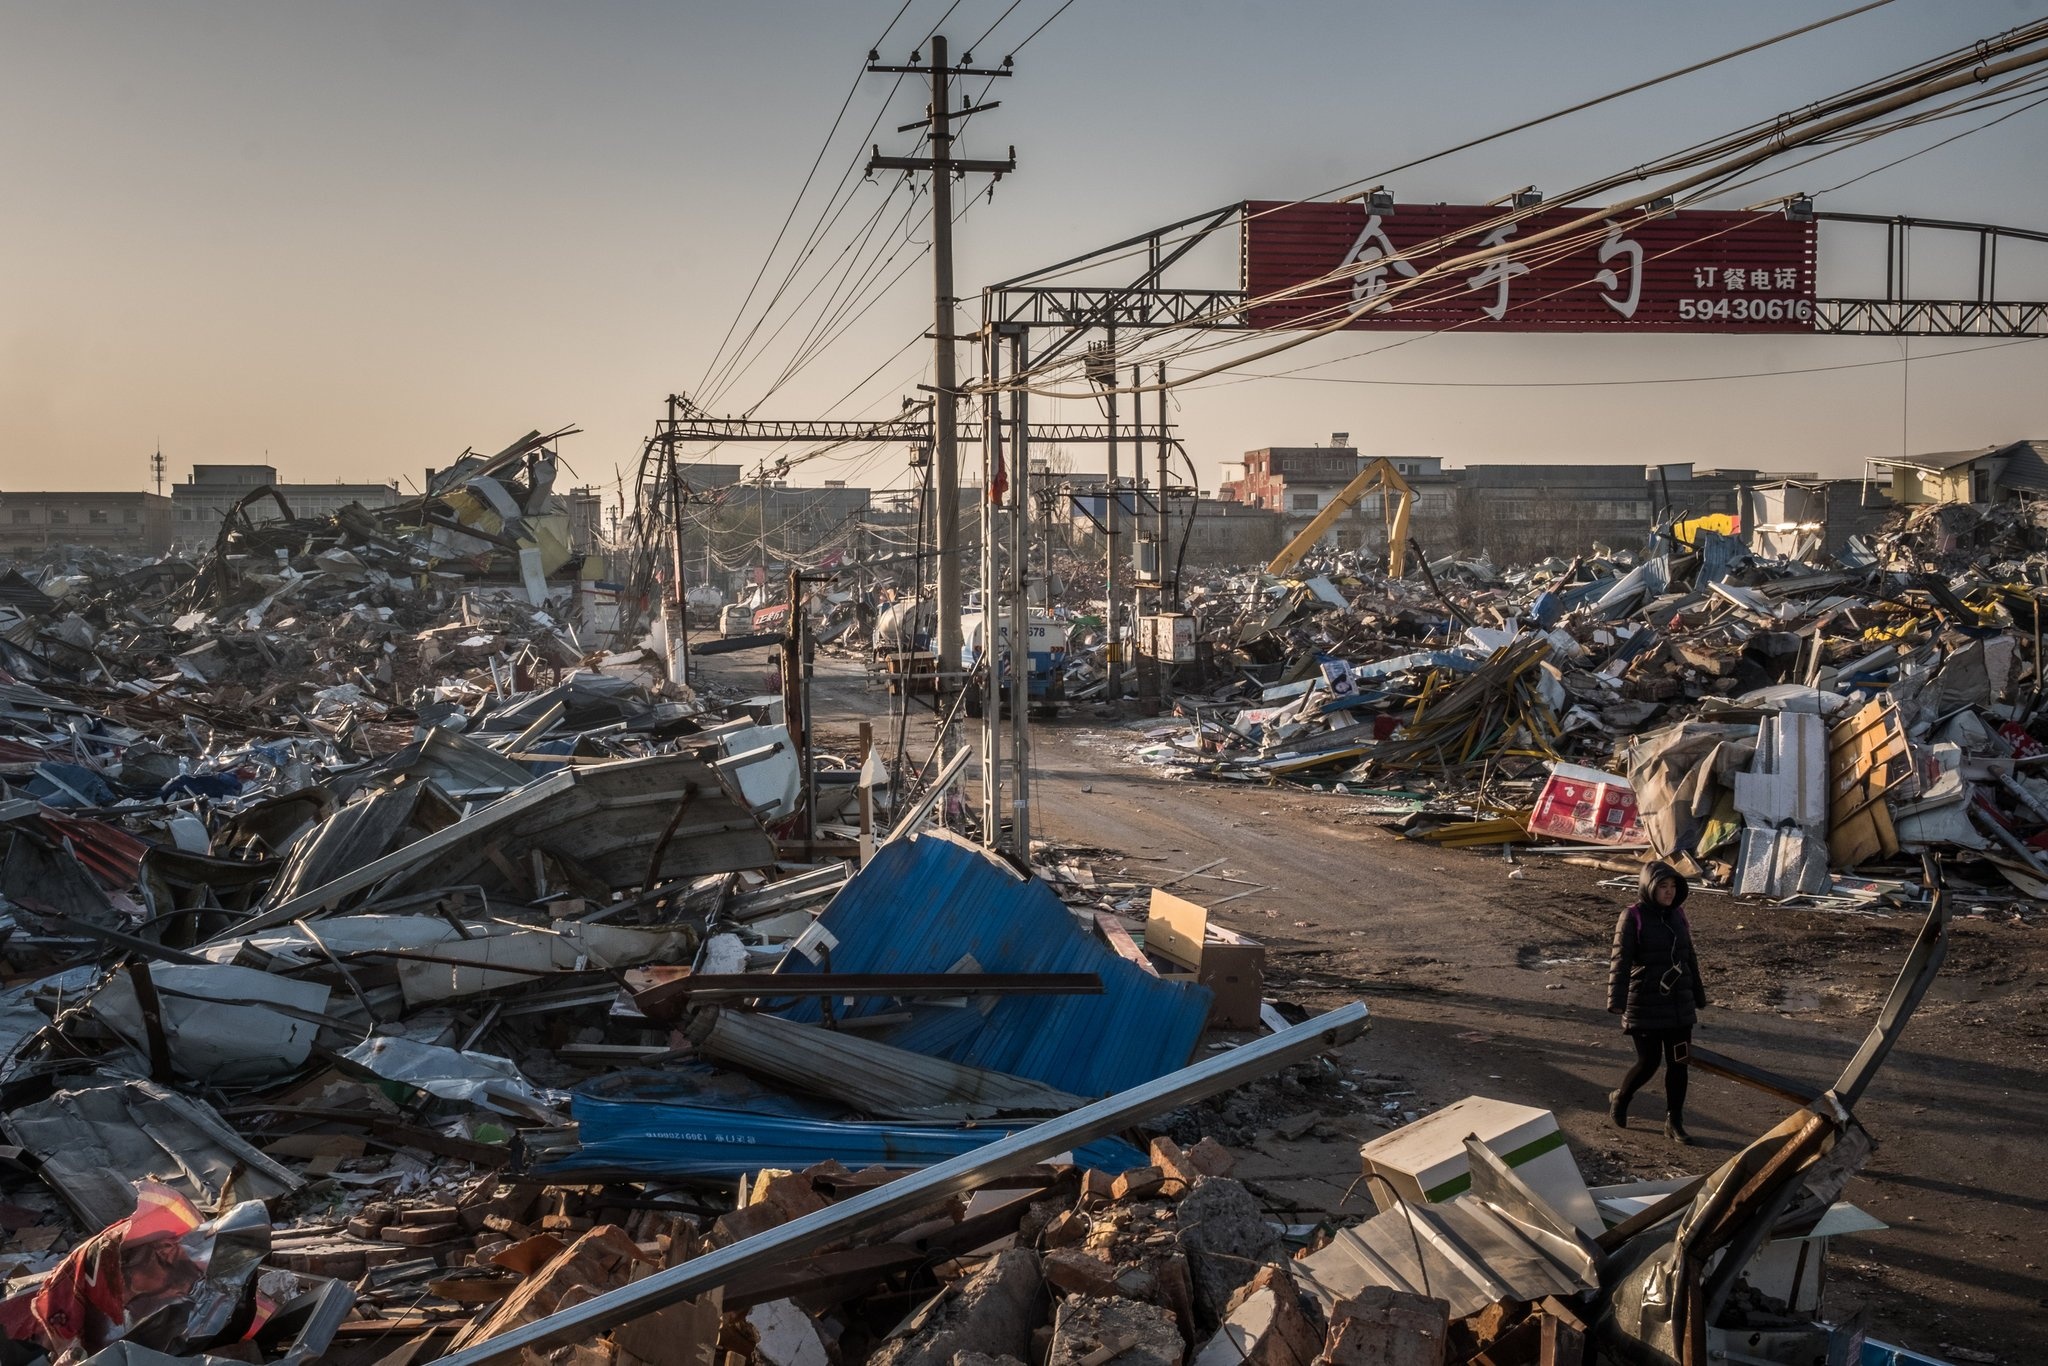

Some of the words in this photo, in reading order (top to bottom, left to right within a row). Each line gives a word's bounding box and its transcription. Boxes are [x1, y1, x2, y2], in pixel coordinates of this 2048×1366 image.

[1339, 214, 1643, 320] 金手勺
[1693, 266, 1797, 291] 订餐电话
[1679, 298, 1812, 320] 59430616
